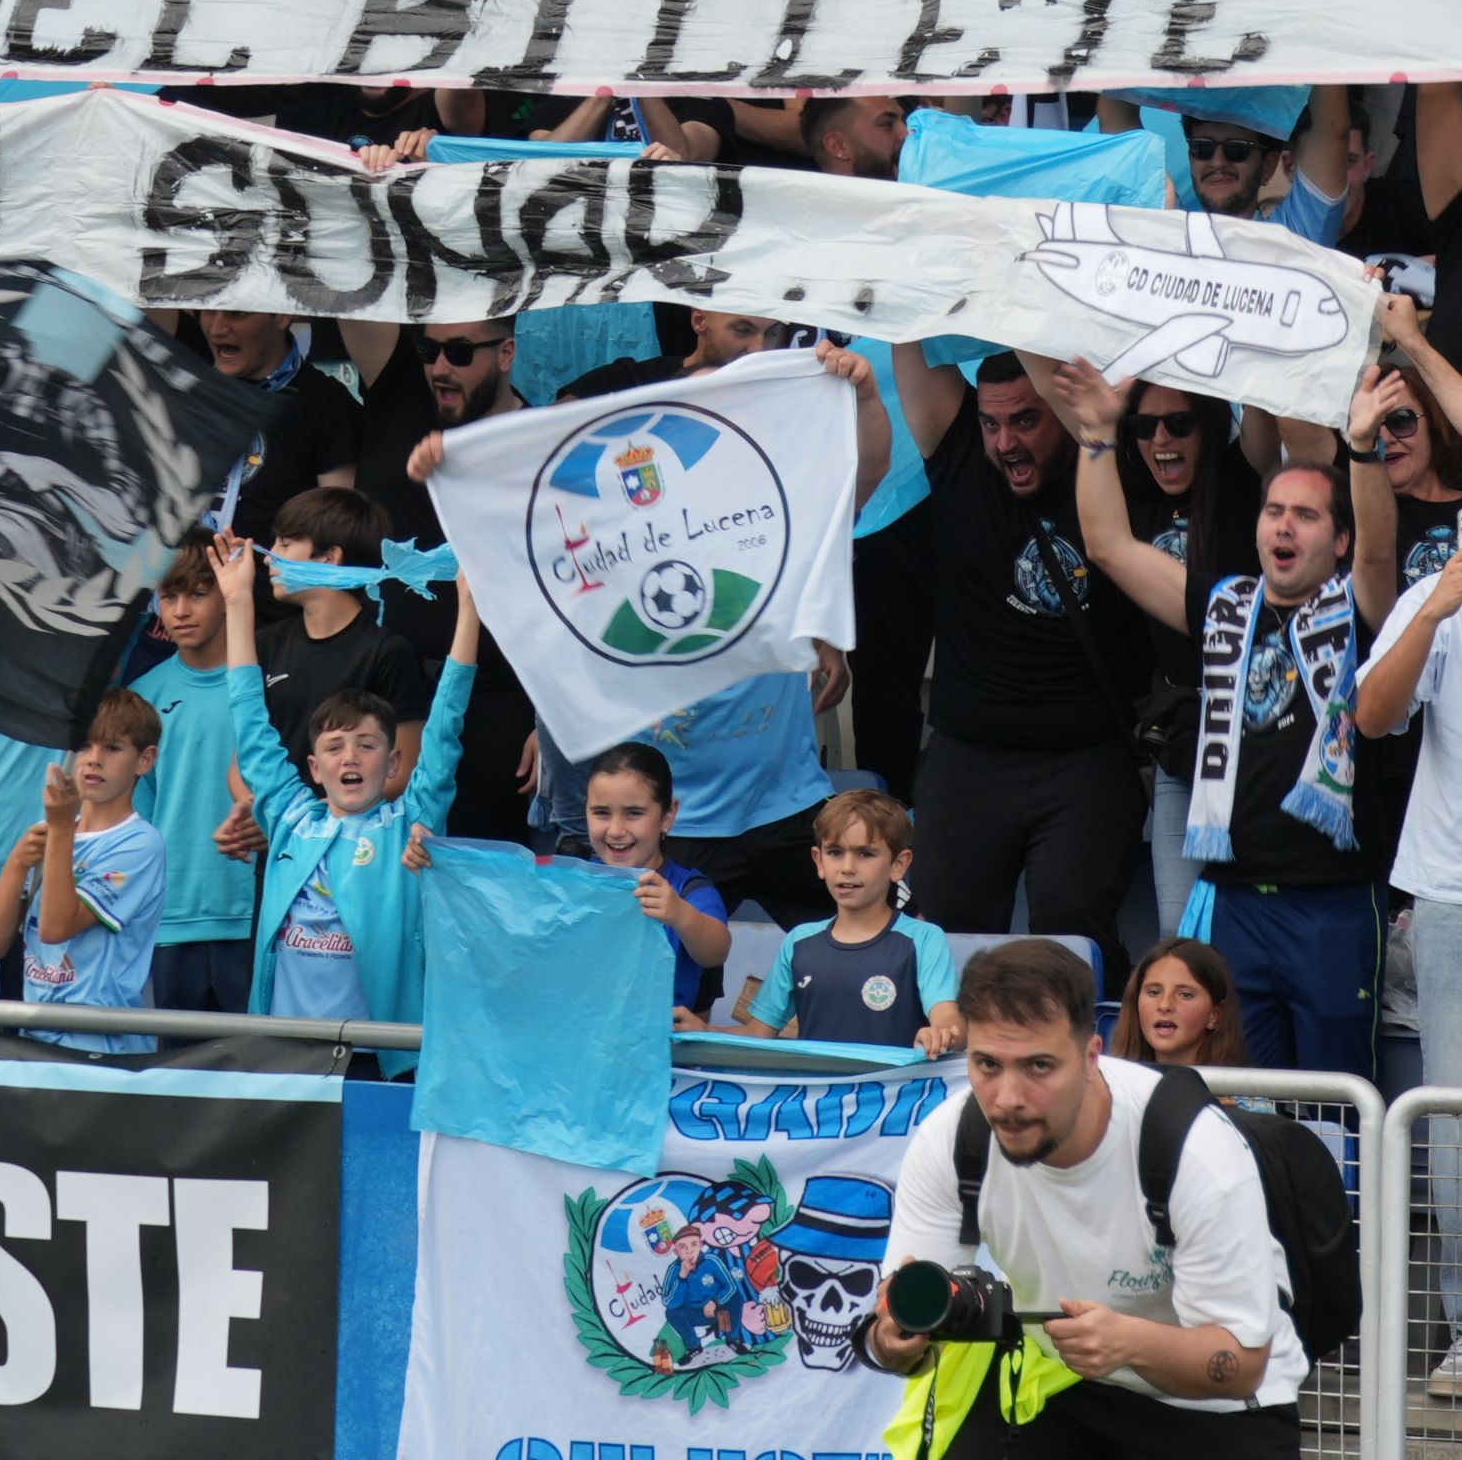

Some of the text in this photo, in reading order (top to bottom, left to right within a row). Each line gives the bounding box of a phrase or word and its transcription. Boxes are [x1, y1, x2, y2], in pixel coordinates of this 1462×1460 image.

[1126, 266, 1275, 318] CD CIUDAD DE LUCENA
[554, 501, 776, 592] Ciudad de Lucena
[286, 925, 353, 952] Aracelita
